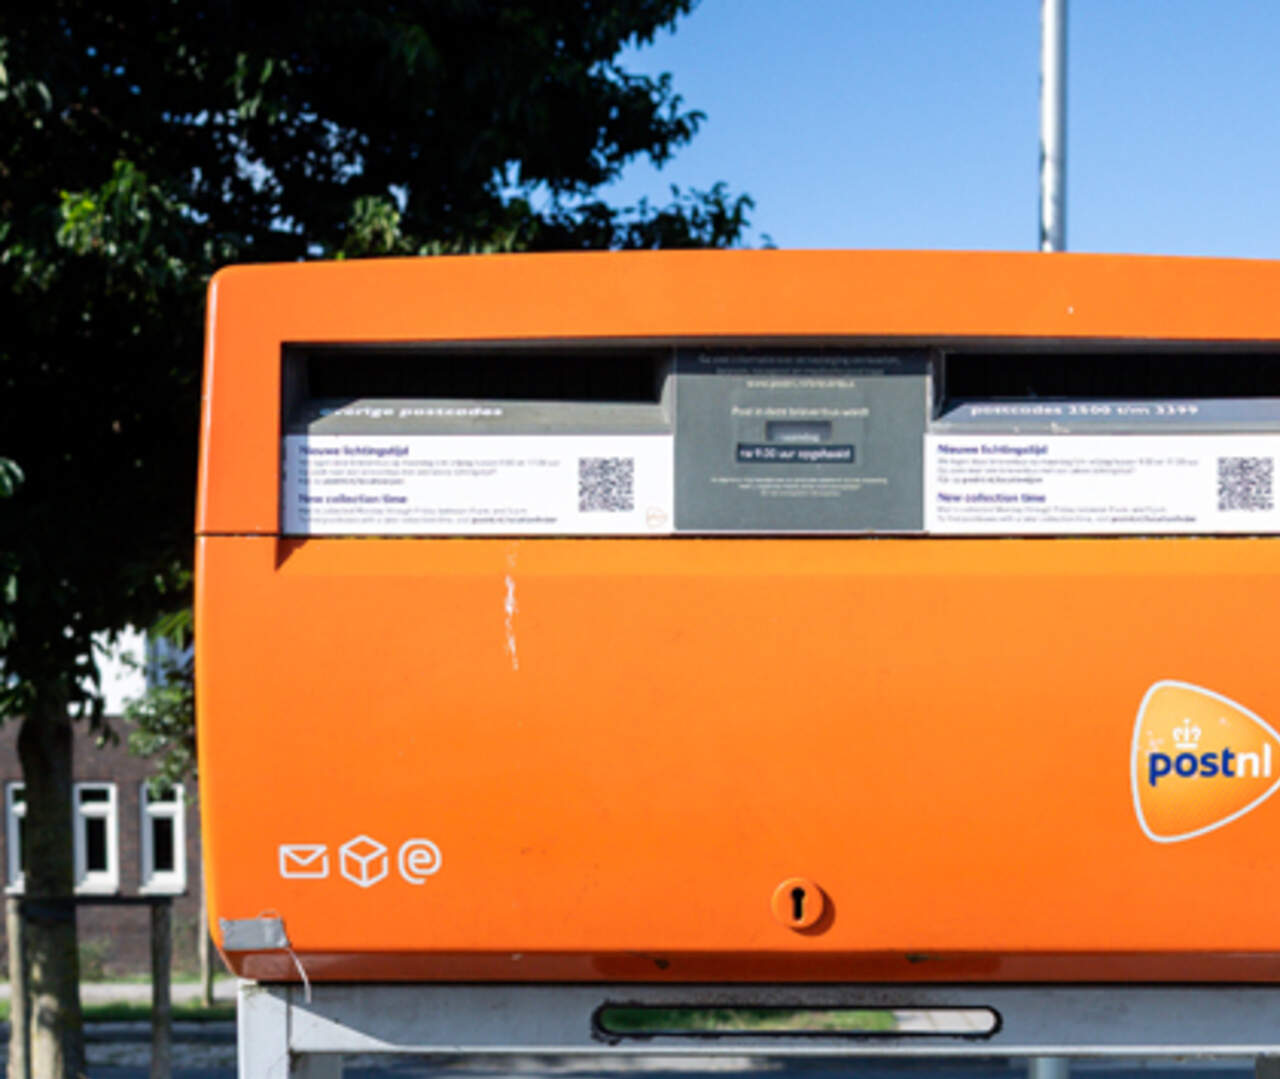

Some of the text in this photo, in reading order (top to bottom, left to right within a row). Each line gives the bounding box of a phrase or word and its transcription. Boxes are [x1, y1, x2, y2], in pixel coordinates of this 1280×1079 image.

[399, 407, 503, 419] postcodes
[970, 404, 1062, 417] postcodes
[1148, 742, 1272, 788] postnl
